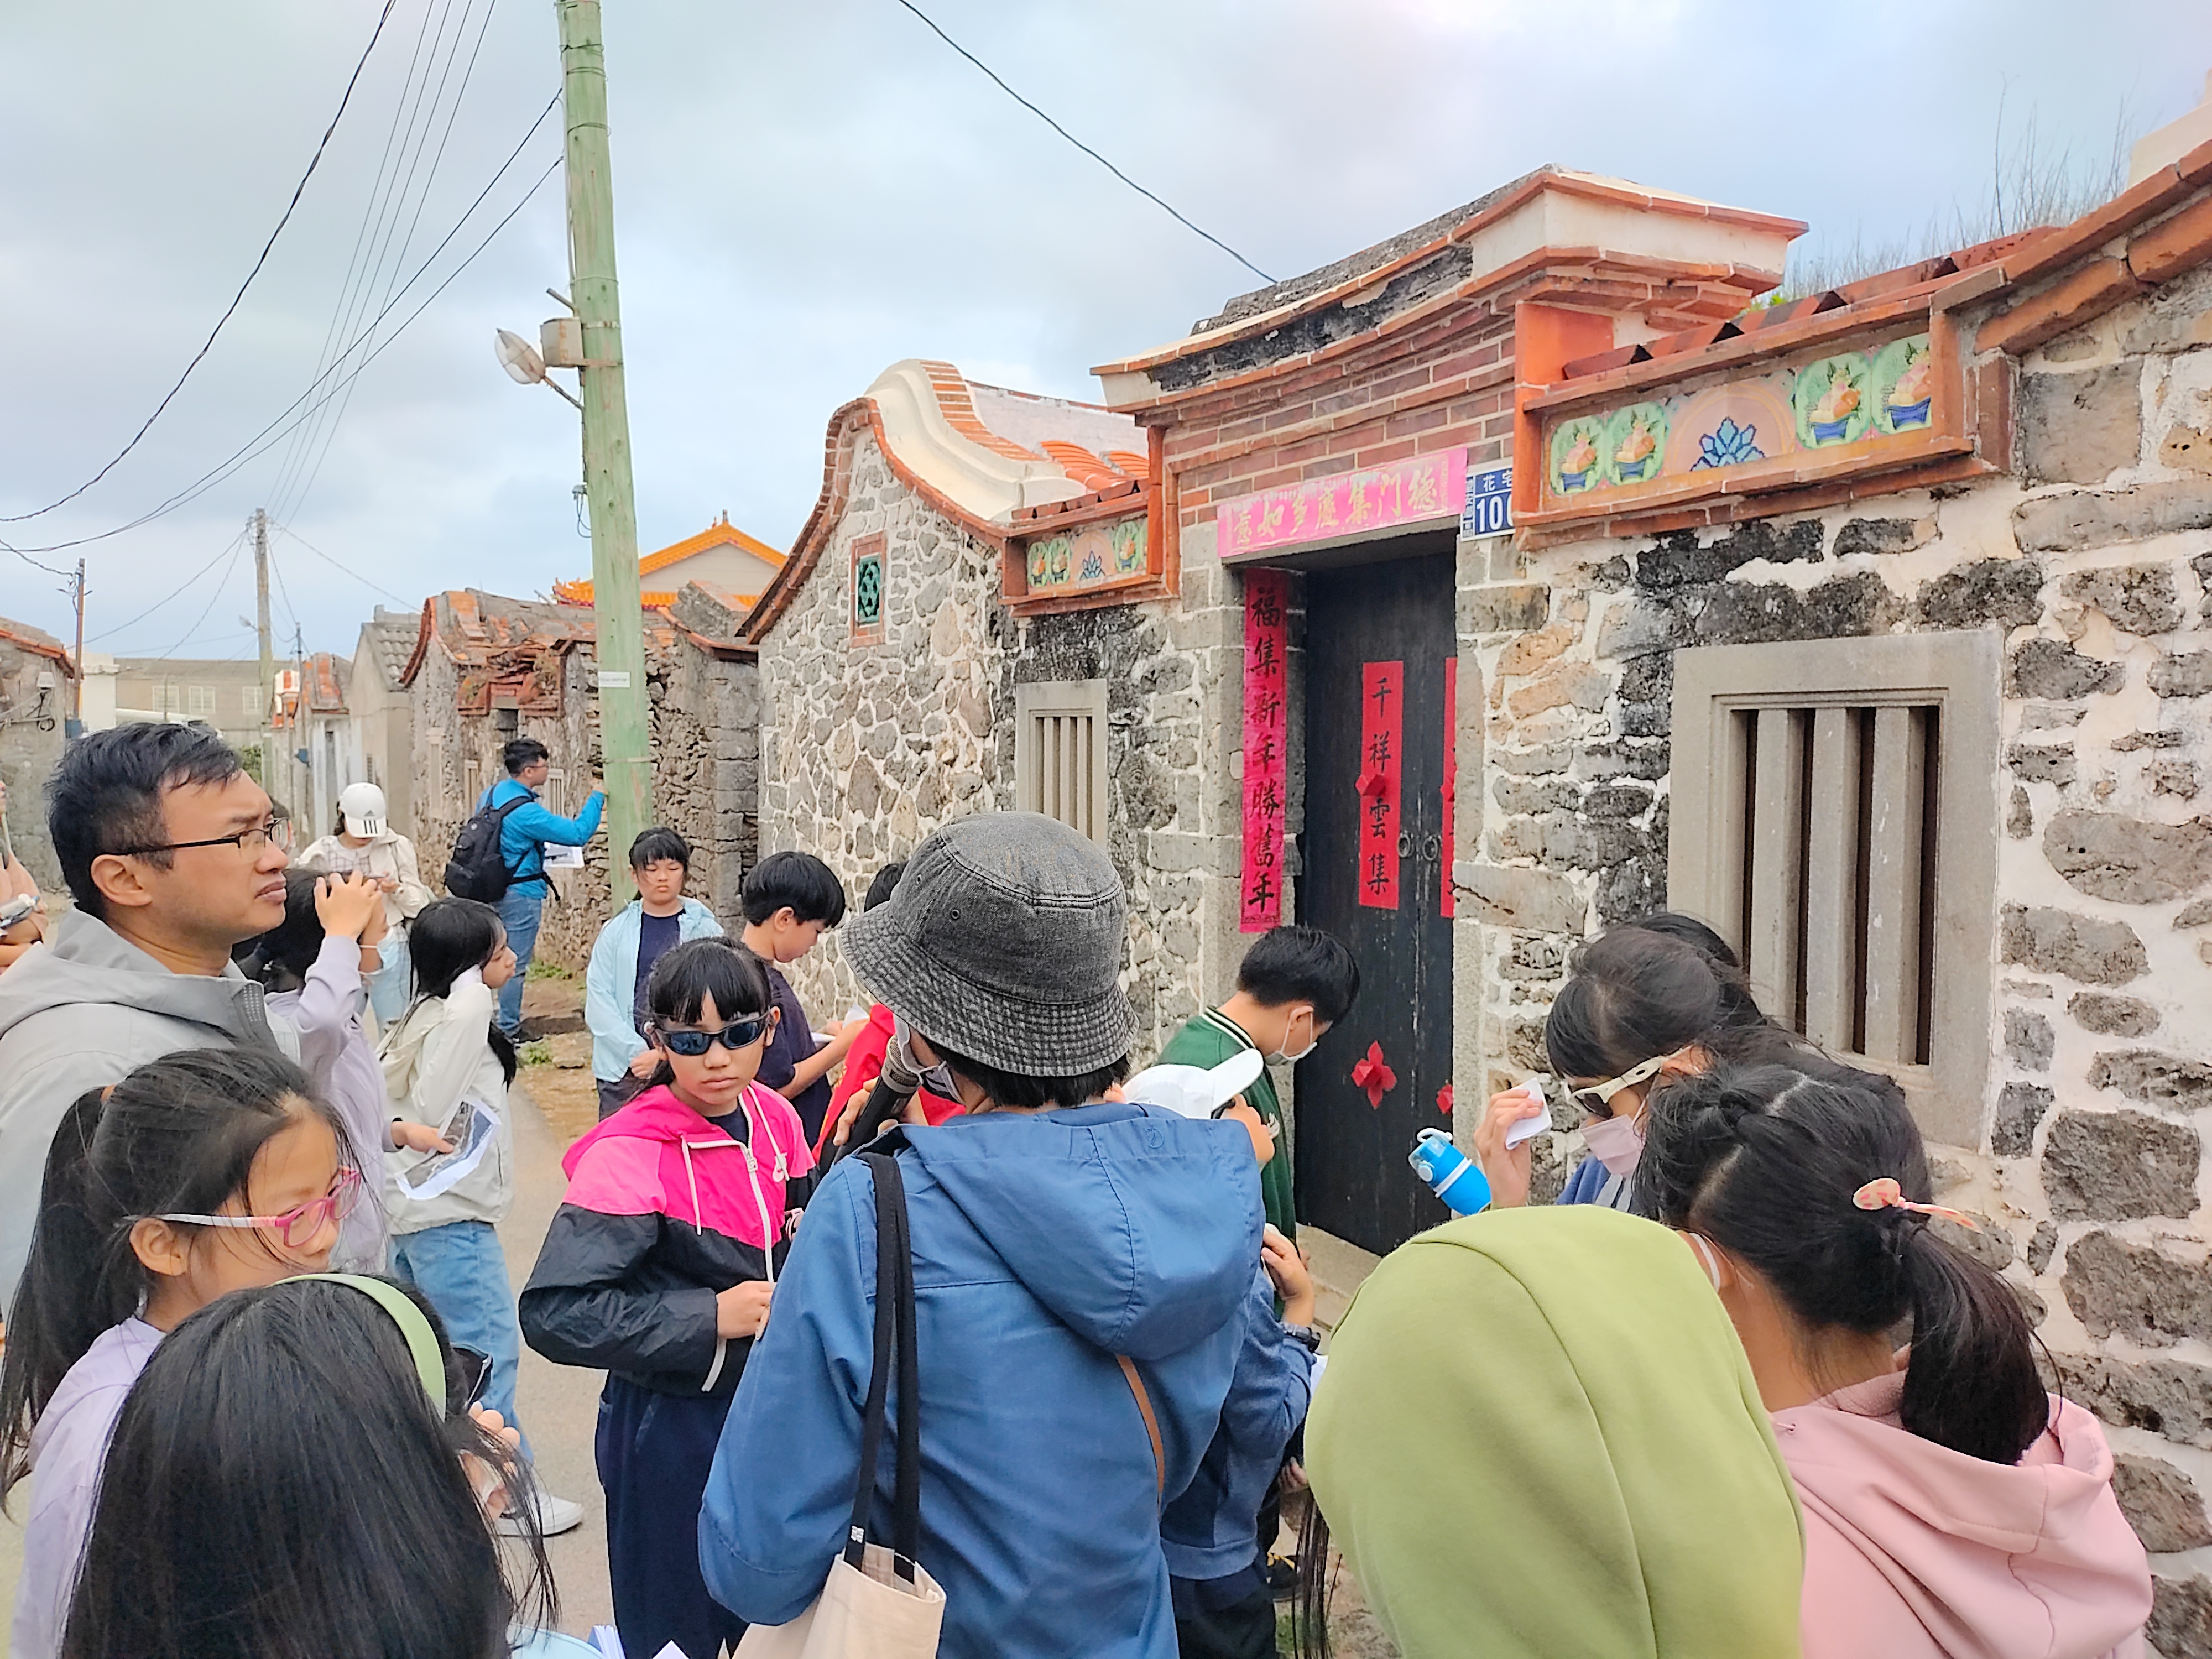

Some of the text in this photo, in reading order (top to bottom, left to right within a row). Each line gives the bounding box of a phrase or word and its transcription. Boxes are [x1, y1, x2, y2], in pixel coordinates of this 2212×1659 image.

[1483, 471, 1512, 492] 花宅
[1367, 677, 1392, 895] 千祥雲集
